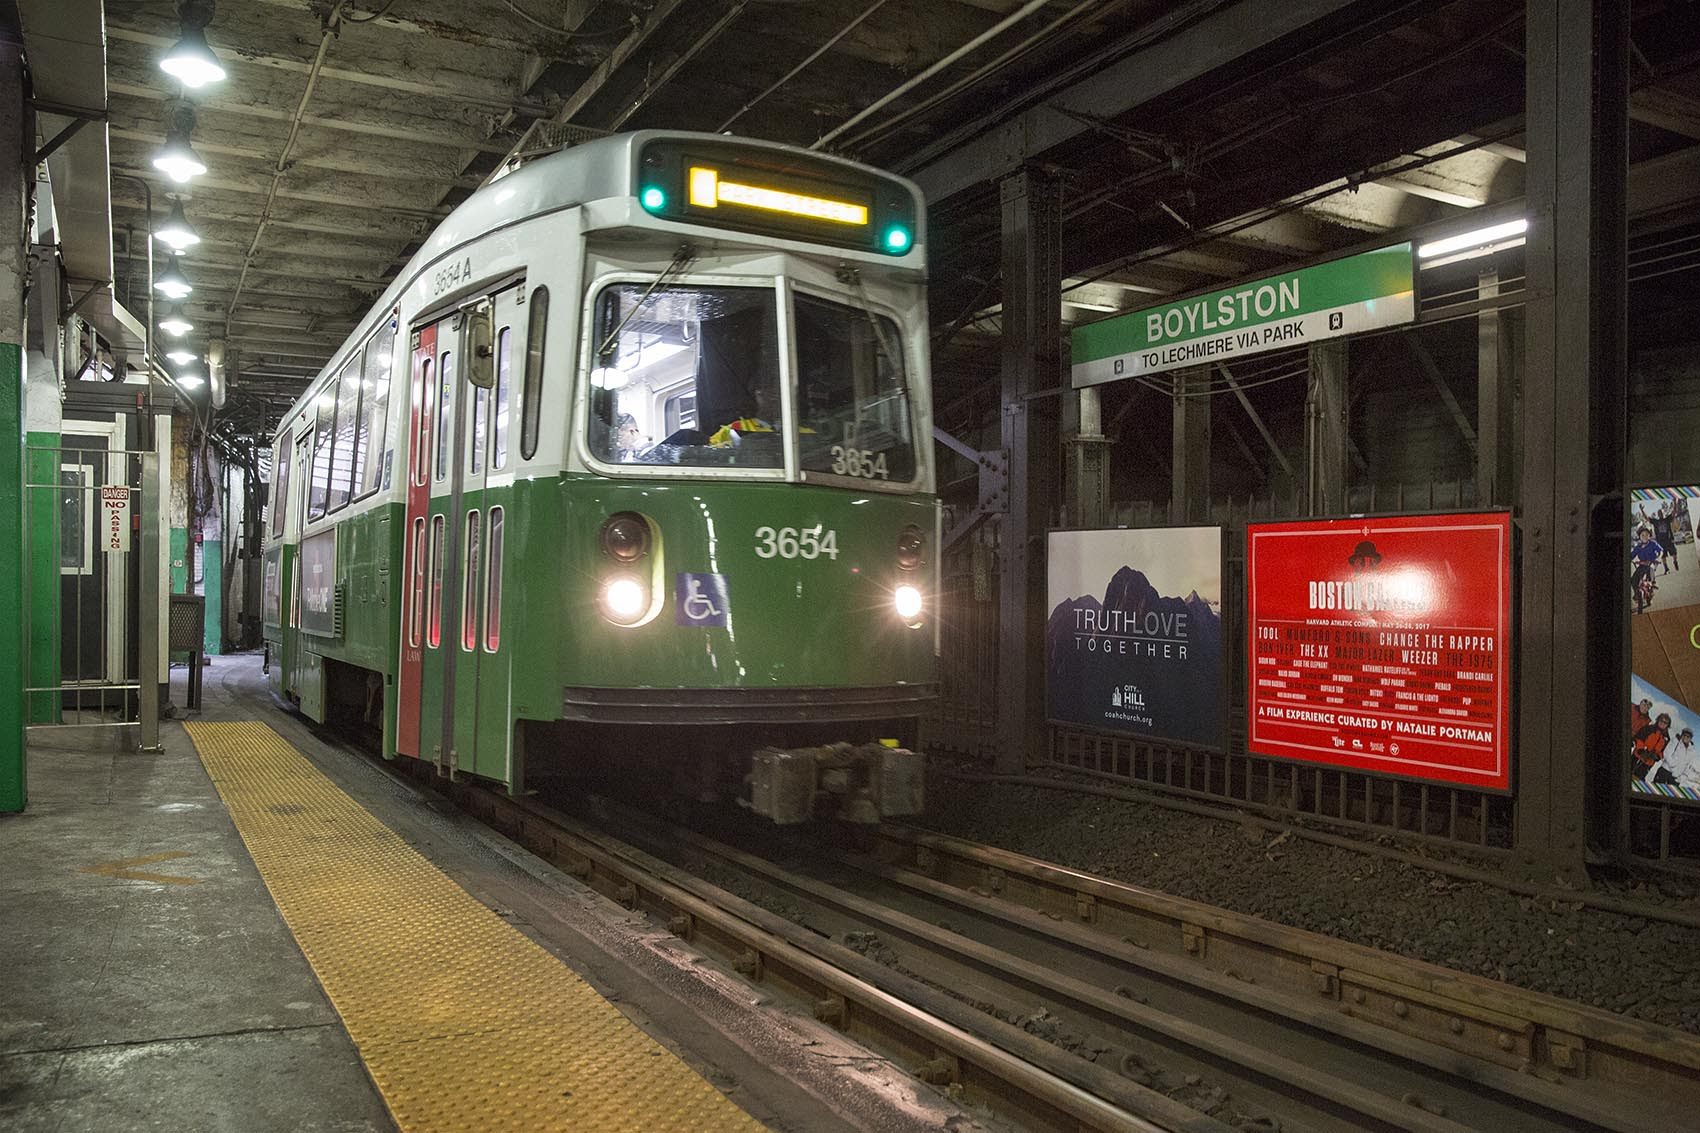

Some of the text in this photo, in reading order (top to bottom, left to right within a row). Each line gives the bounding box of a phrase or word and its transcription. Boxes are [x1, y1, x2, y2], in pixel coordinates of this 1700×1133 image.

[1147, 278, 1300, 342] BOYLSTON
[1142, 321, 1305, 368] TO LECHMERE VIA PARK
[830, 446, 889, 479] 3654
[103, 488, 128, 499] DANGER
[111, 509, 120, 549] PASSING
[755, 526, 840, 560] 3654
[1309, 581, 1361, 610] BOSTON
[1330, 619, 1352, 627] ATHLETIC
[1075, 637, 1187, 660] TOGETHER
[1258, 626, 1278, 640] TOOL
[1287, 628, 1330, 642] MUMFORD
[1346, 630, 1371, 644] SONS
[1379, 632, 1419, 648] CHANCE
[1425, 634, 1444, 649] THE
[1450, 635, 1494, 652] RAPPER
[1300, 644, 1315, 658] THE
[1318, 645, 1329, 659] XX
[1335, 646, 1363, 660] MAJOR
[1401, 649, 1438, 665] WEEZER
[1446, 652, 1463, 667] THE
[1124, 684, 1137, 692] CITY
[1124, 692, 1145, 706] HILL
[1104, 711, 1153, 726] coahchurch.org
[1258, 706, 1264, 715] A
[1266, 707, 1284, 718] FILM
[1286, 709, 1335, 725] EXPERIENCE
[1338, 714, 1378, 729] CURATED
[1381, 720, 1393, 731] BY
[1397, 722, 1437, 737] NATALIE
[1440, 727, 1492, 742] PORTMAN
